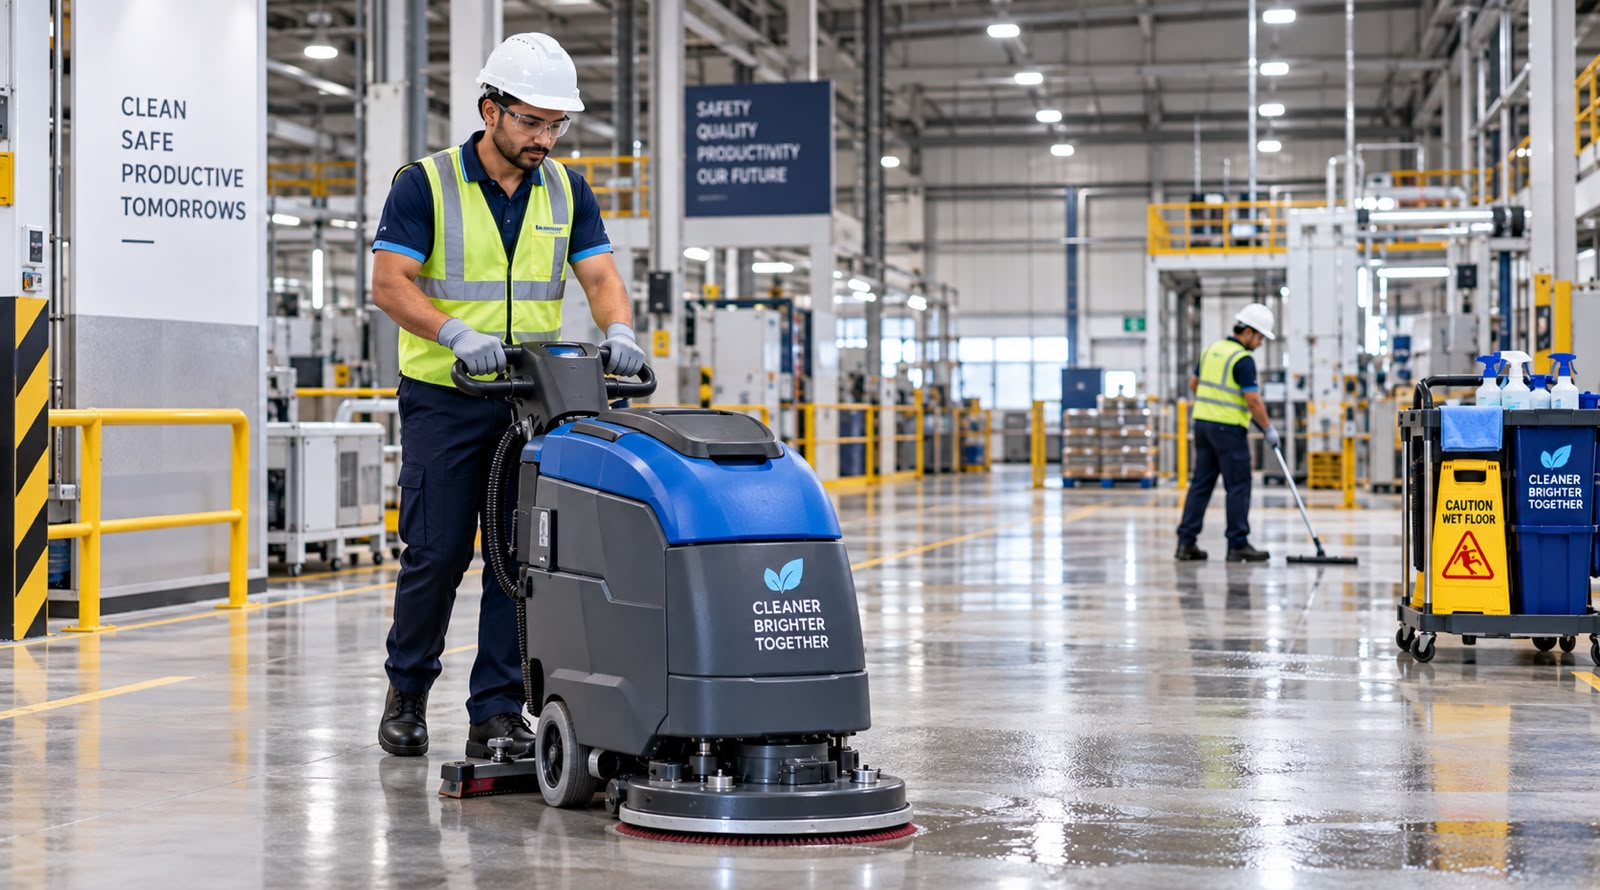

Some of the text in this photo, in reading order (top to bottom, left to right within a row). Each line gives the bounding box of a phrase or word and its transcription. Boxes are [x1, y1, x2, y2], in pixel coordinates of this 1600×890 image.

[121, 96, 187, 120] CLEAN
[696, 99, 752, 118] SAFETY
[696, 122, 758, 141] QUALITY
[121, 129, 174, 152] SAFE
[696, 143, 801, 162] PRODUCTIVITY
[121, 163, 244, 188] PRODUCTIVE
[696, 166, 788, 185] OUR FUTURE
[120, 196, 247, 221] TOMORROWS
[1528, 474, 1581, 485] CLEANER
[1528, 487, 1582, 498] BRIGHTER
[1445, 499, 1493, 511] CAUTION
[1528, 499, 1583, 510] TOGETHER
[1442, 513, 1496, 524] WET FLOOR
[752, 599, 821, 615] CLEANER
[753, 617, 826, 633] BRIGHTER
[754, 635, 829, 651] TOGETHER
